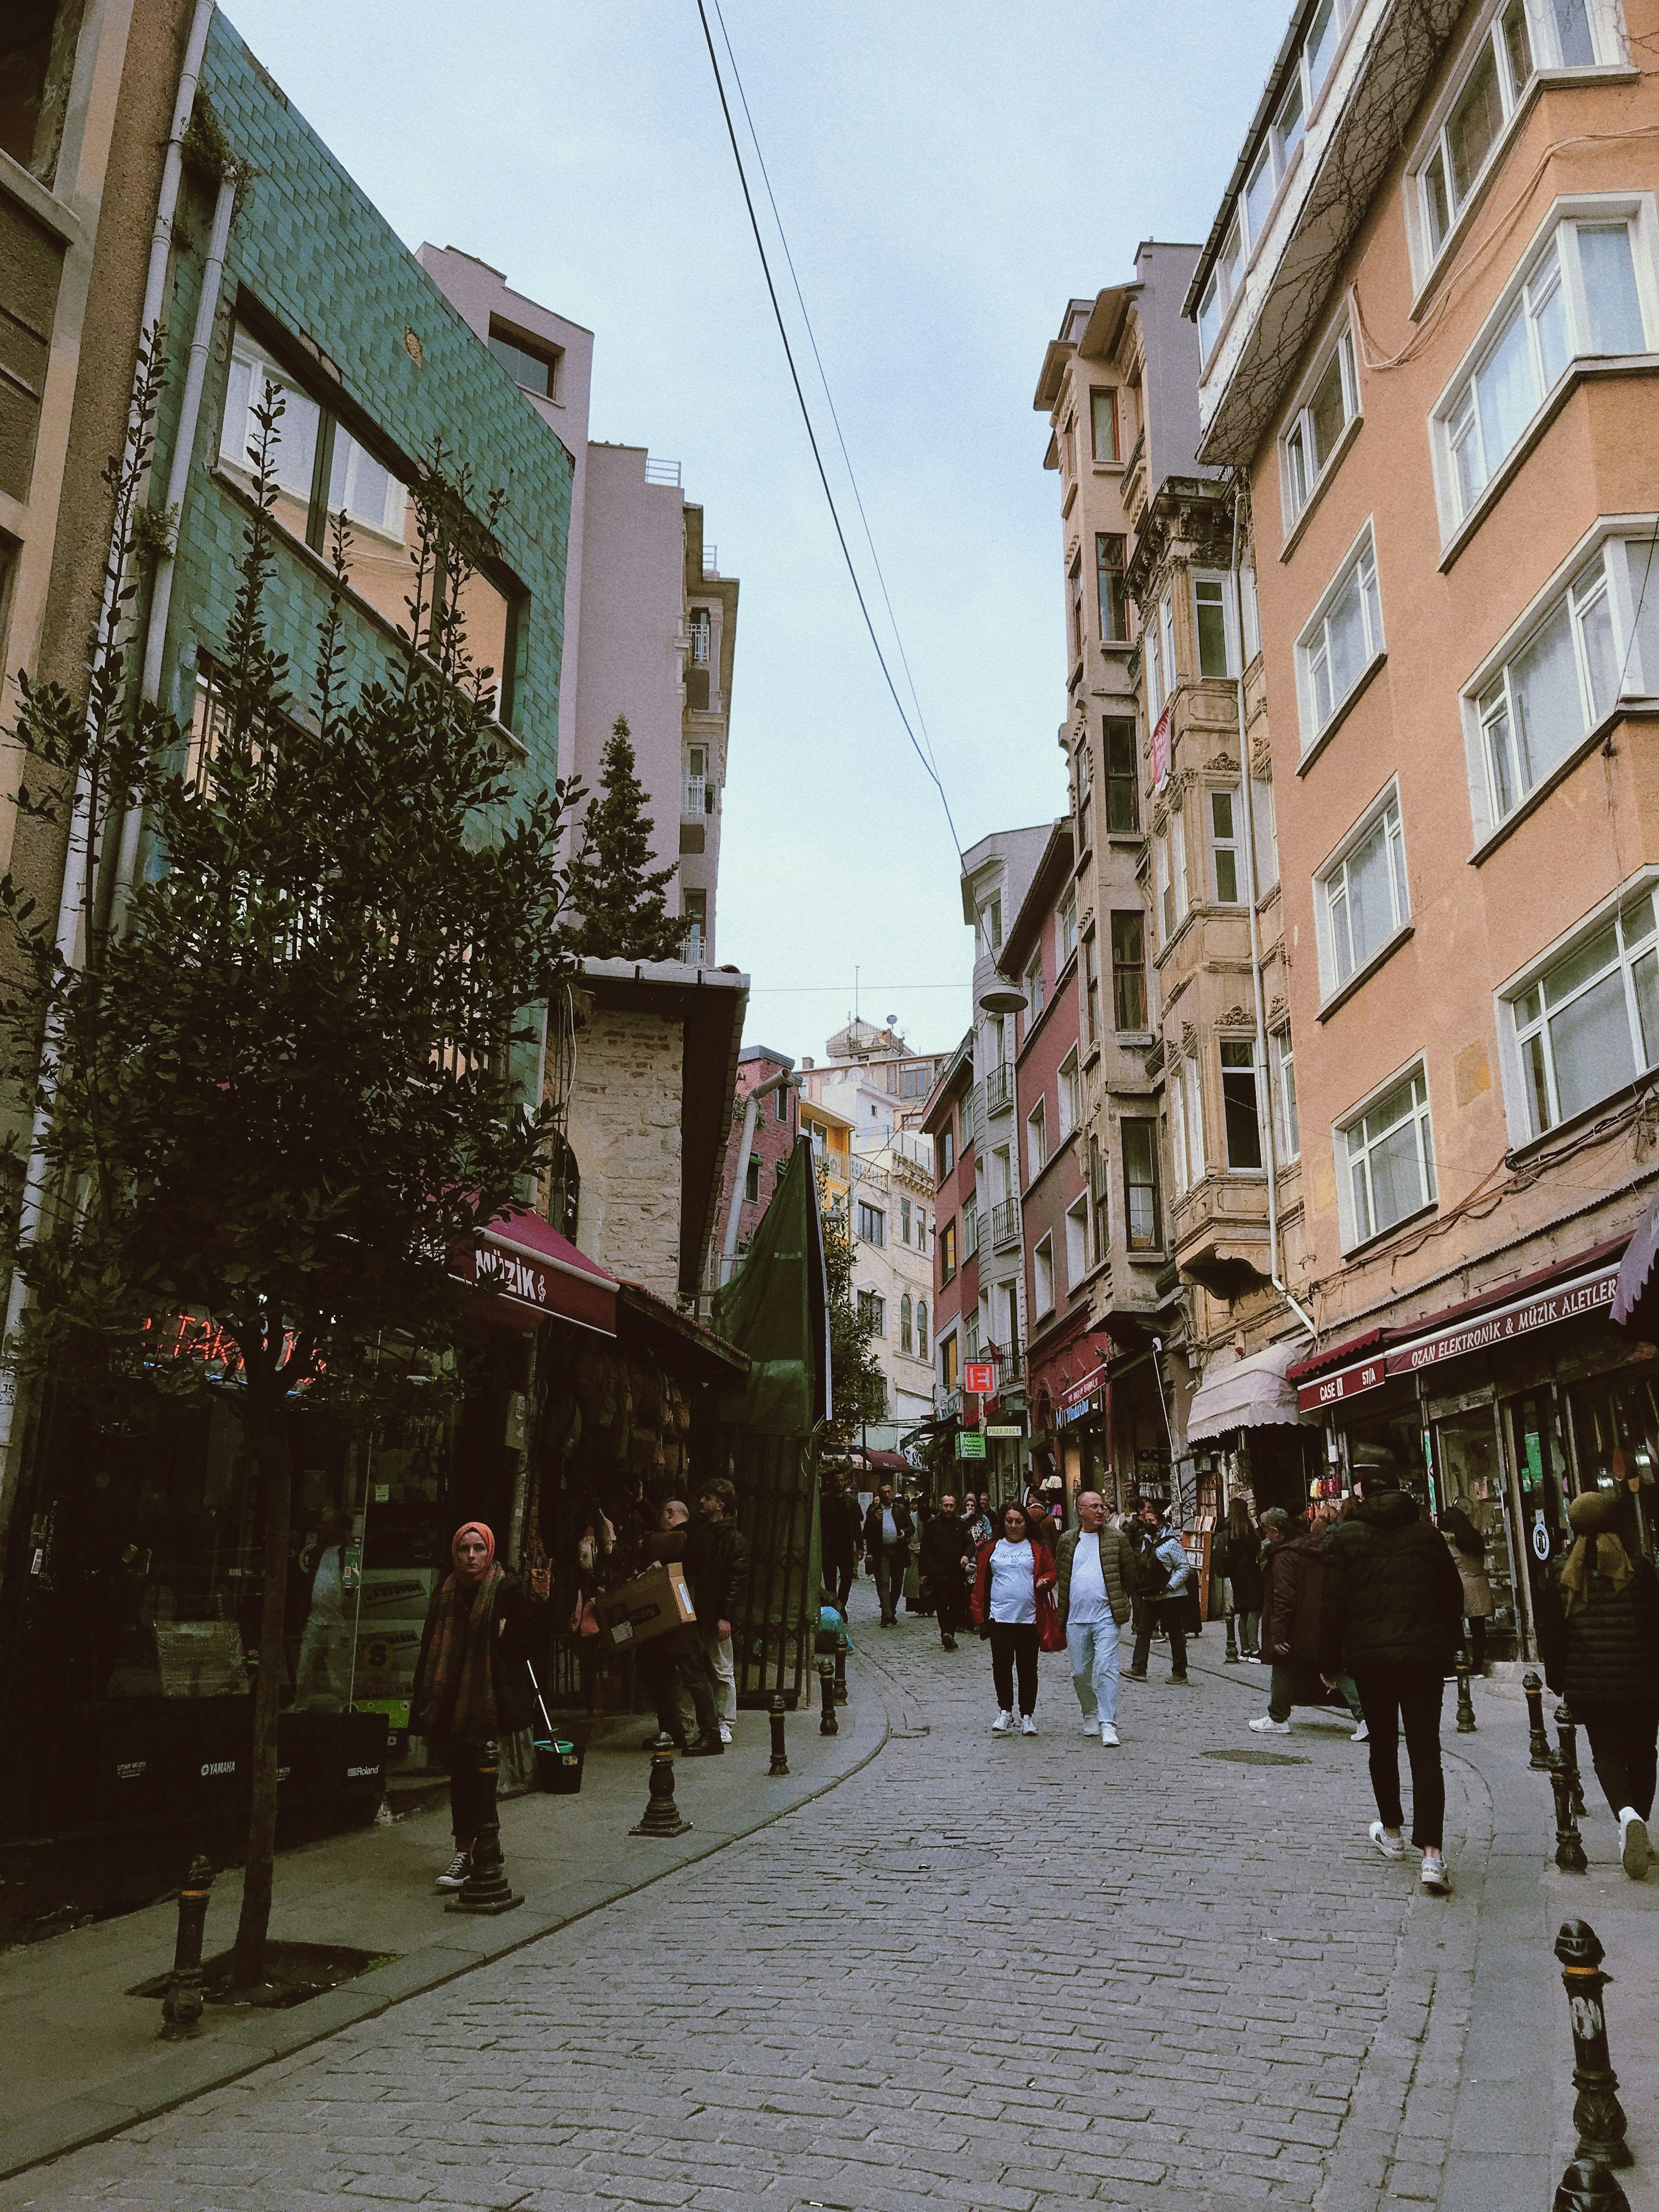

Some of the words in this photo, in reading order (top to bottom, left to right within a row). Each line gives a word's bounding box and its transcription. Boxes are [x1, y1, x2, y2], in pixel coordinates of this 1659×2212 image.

[1411, 1347, 1436, 1367] OZAN
[1438, 1321, 1501, 1358] ELEKTRONİK
[1505, 1317, 1514, 1334] &
[1518, 1301, 1558, 1330] MÜZİK
[1562, 1273, 1621, 1315] ALETLER
[1319, 1382, 1336, 1401] CASE
[210, 1761, 235, 1774] YAMAHA
[357, 1765, 379, 1775] Roland
